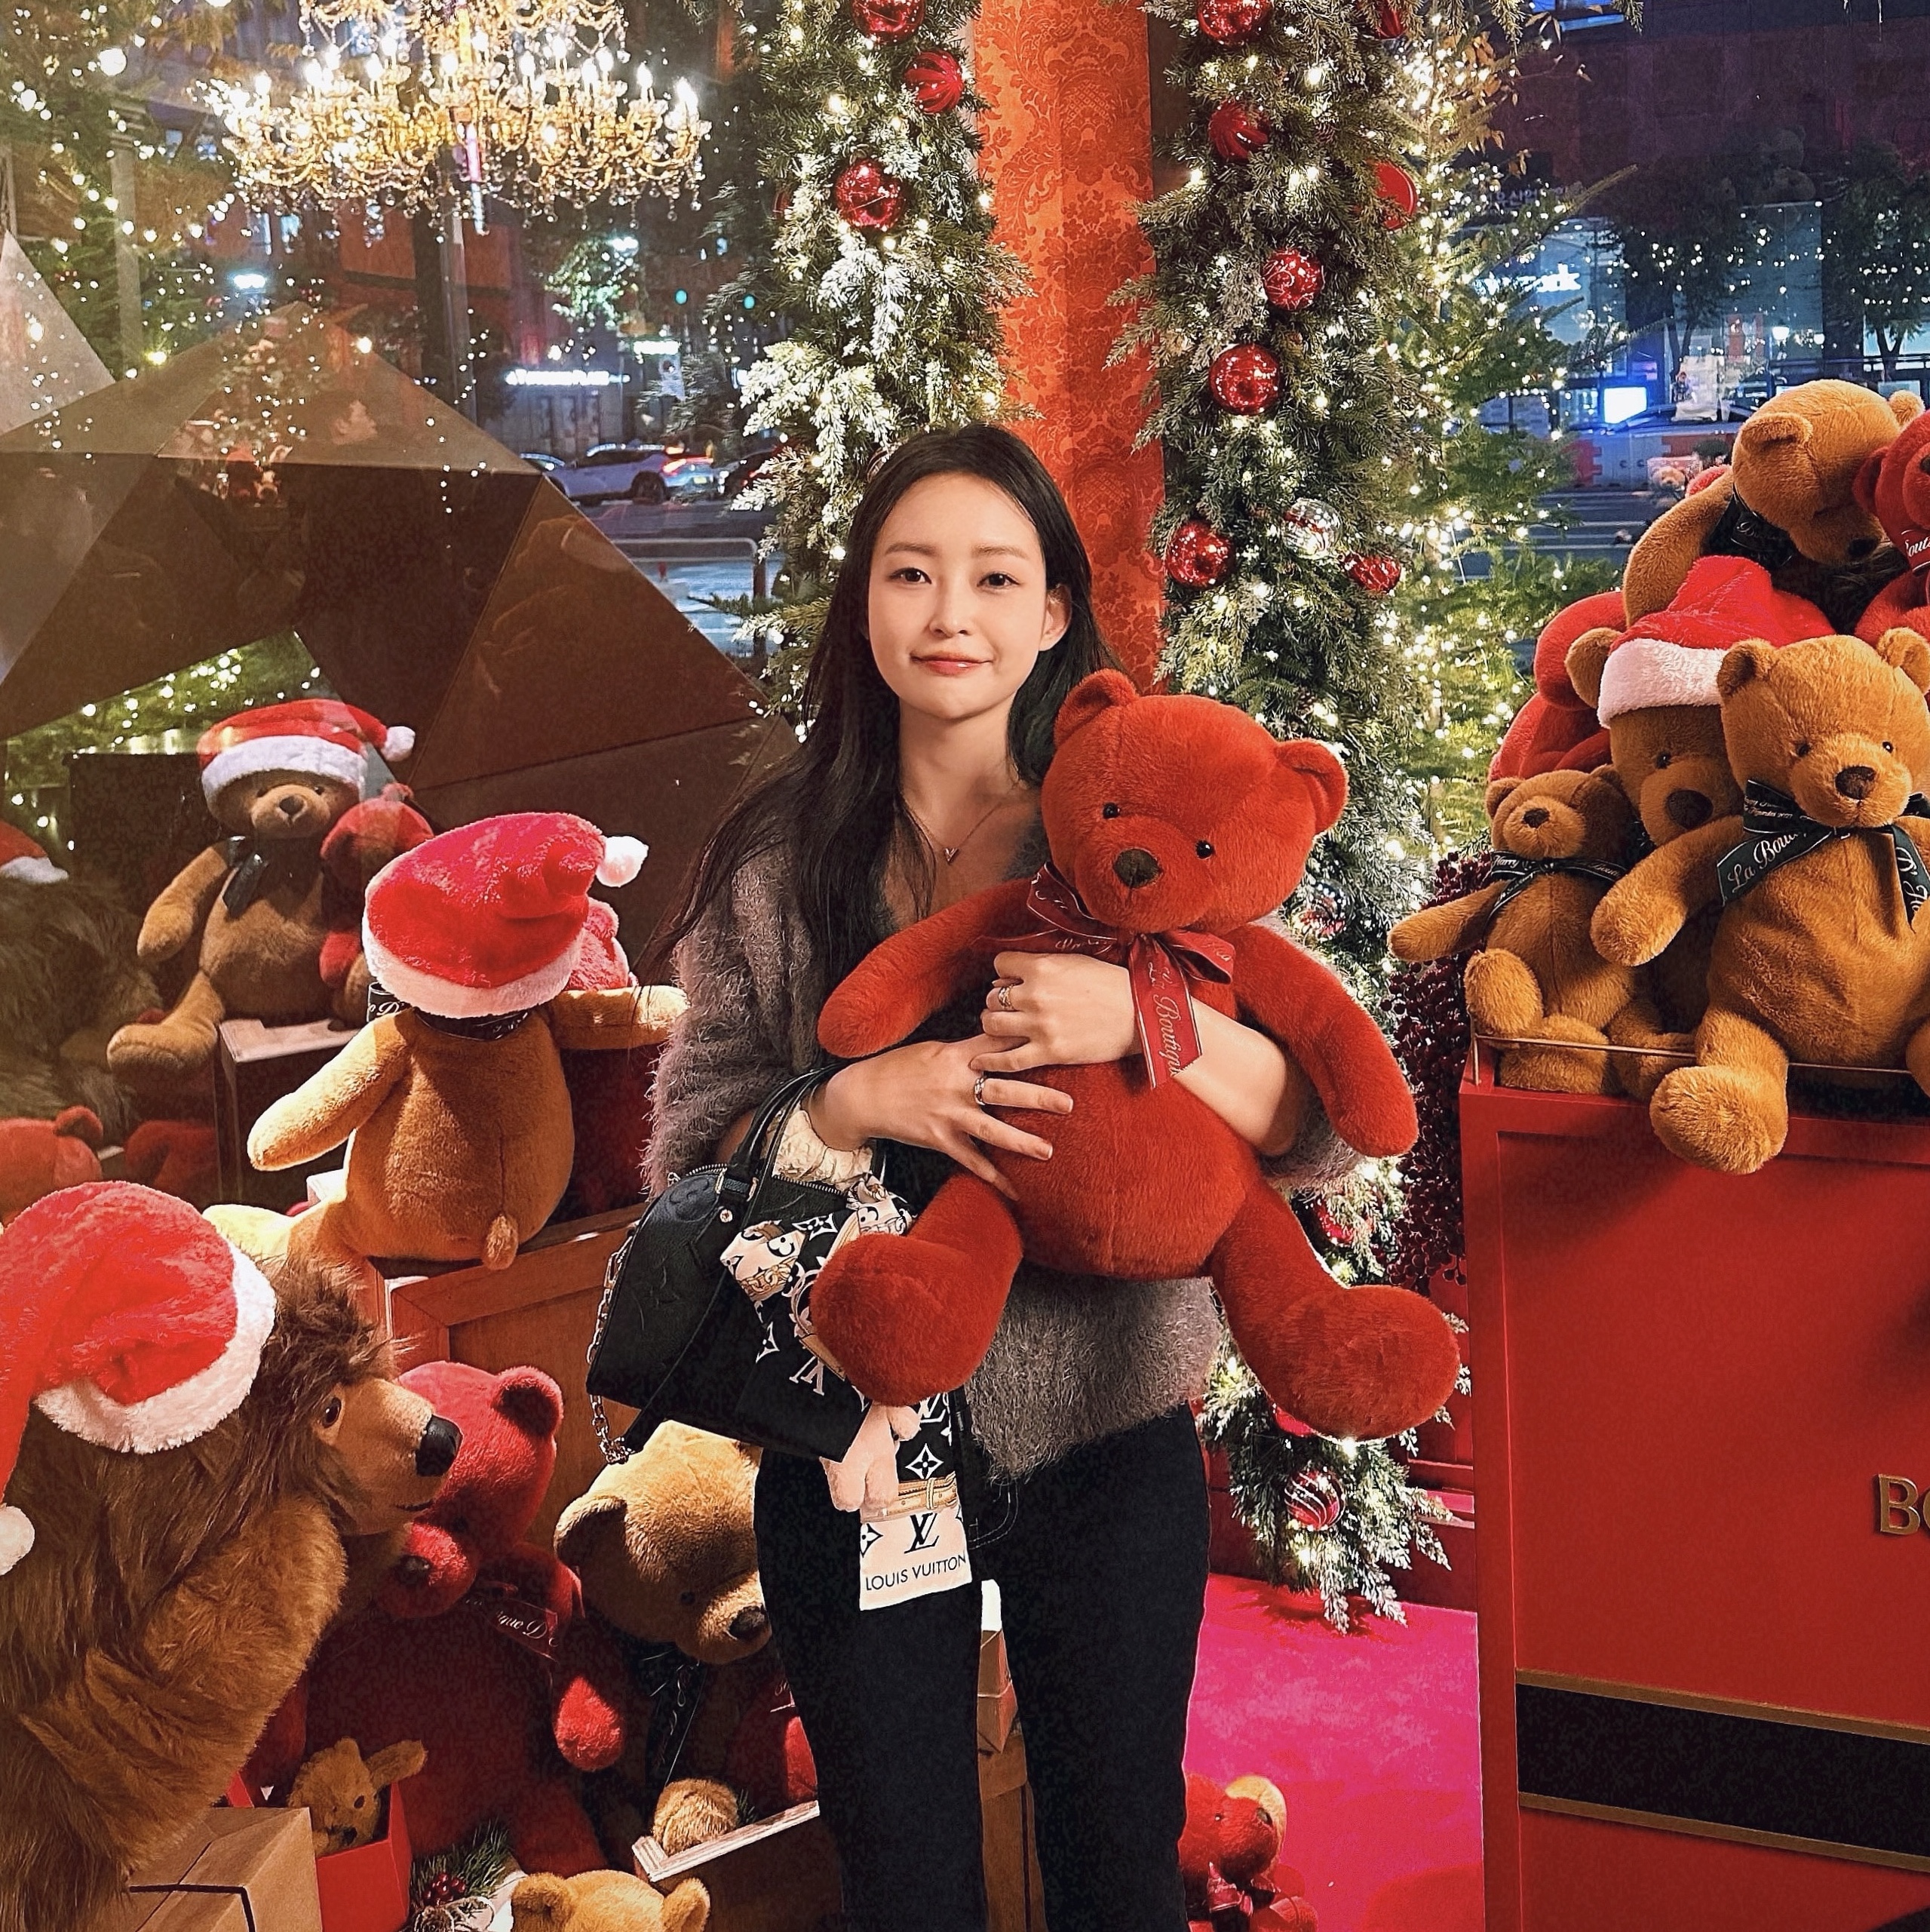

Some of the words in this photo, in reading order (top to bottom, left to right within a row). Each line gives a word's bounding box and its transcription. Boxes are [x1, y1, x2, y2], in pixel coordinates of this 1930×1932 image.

[1492, 855, 1520, 868] Harry
[1727, 864, 1756, 893] La
[1878, 1473, 1930, 1535] B
[866, 1569, 908, 1591] LOUIS
[912, 1549, 966, 1579] VUITTON
